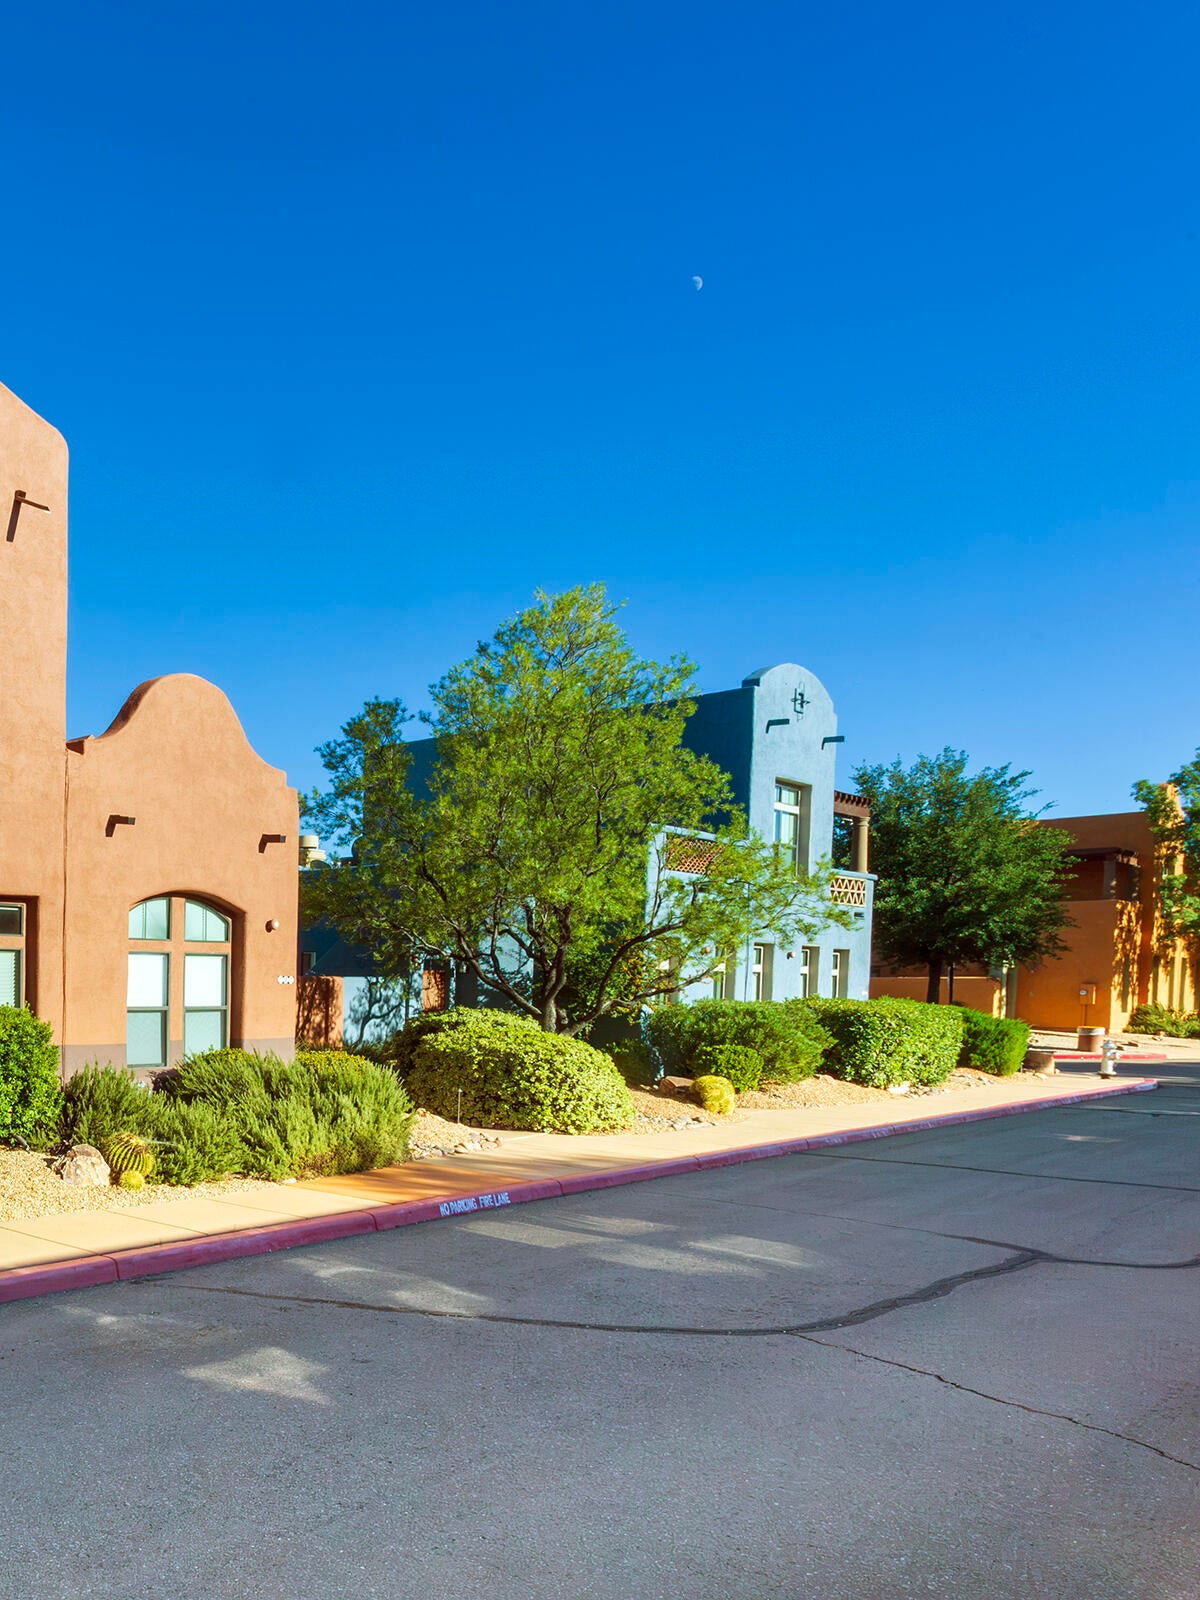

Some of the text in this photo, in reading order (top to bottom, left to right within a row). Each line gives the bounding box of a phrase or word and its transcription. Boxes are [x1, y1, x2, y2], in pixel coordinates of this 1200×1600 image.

[439, 1192, 511, 1216] NO PARKING FIRE LANE
